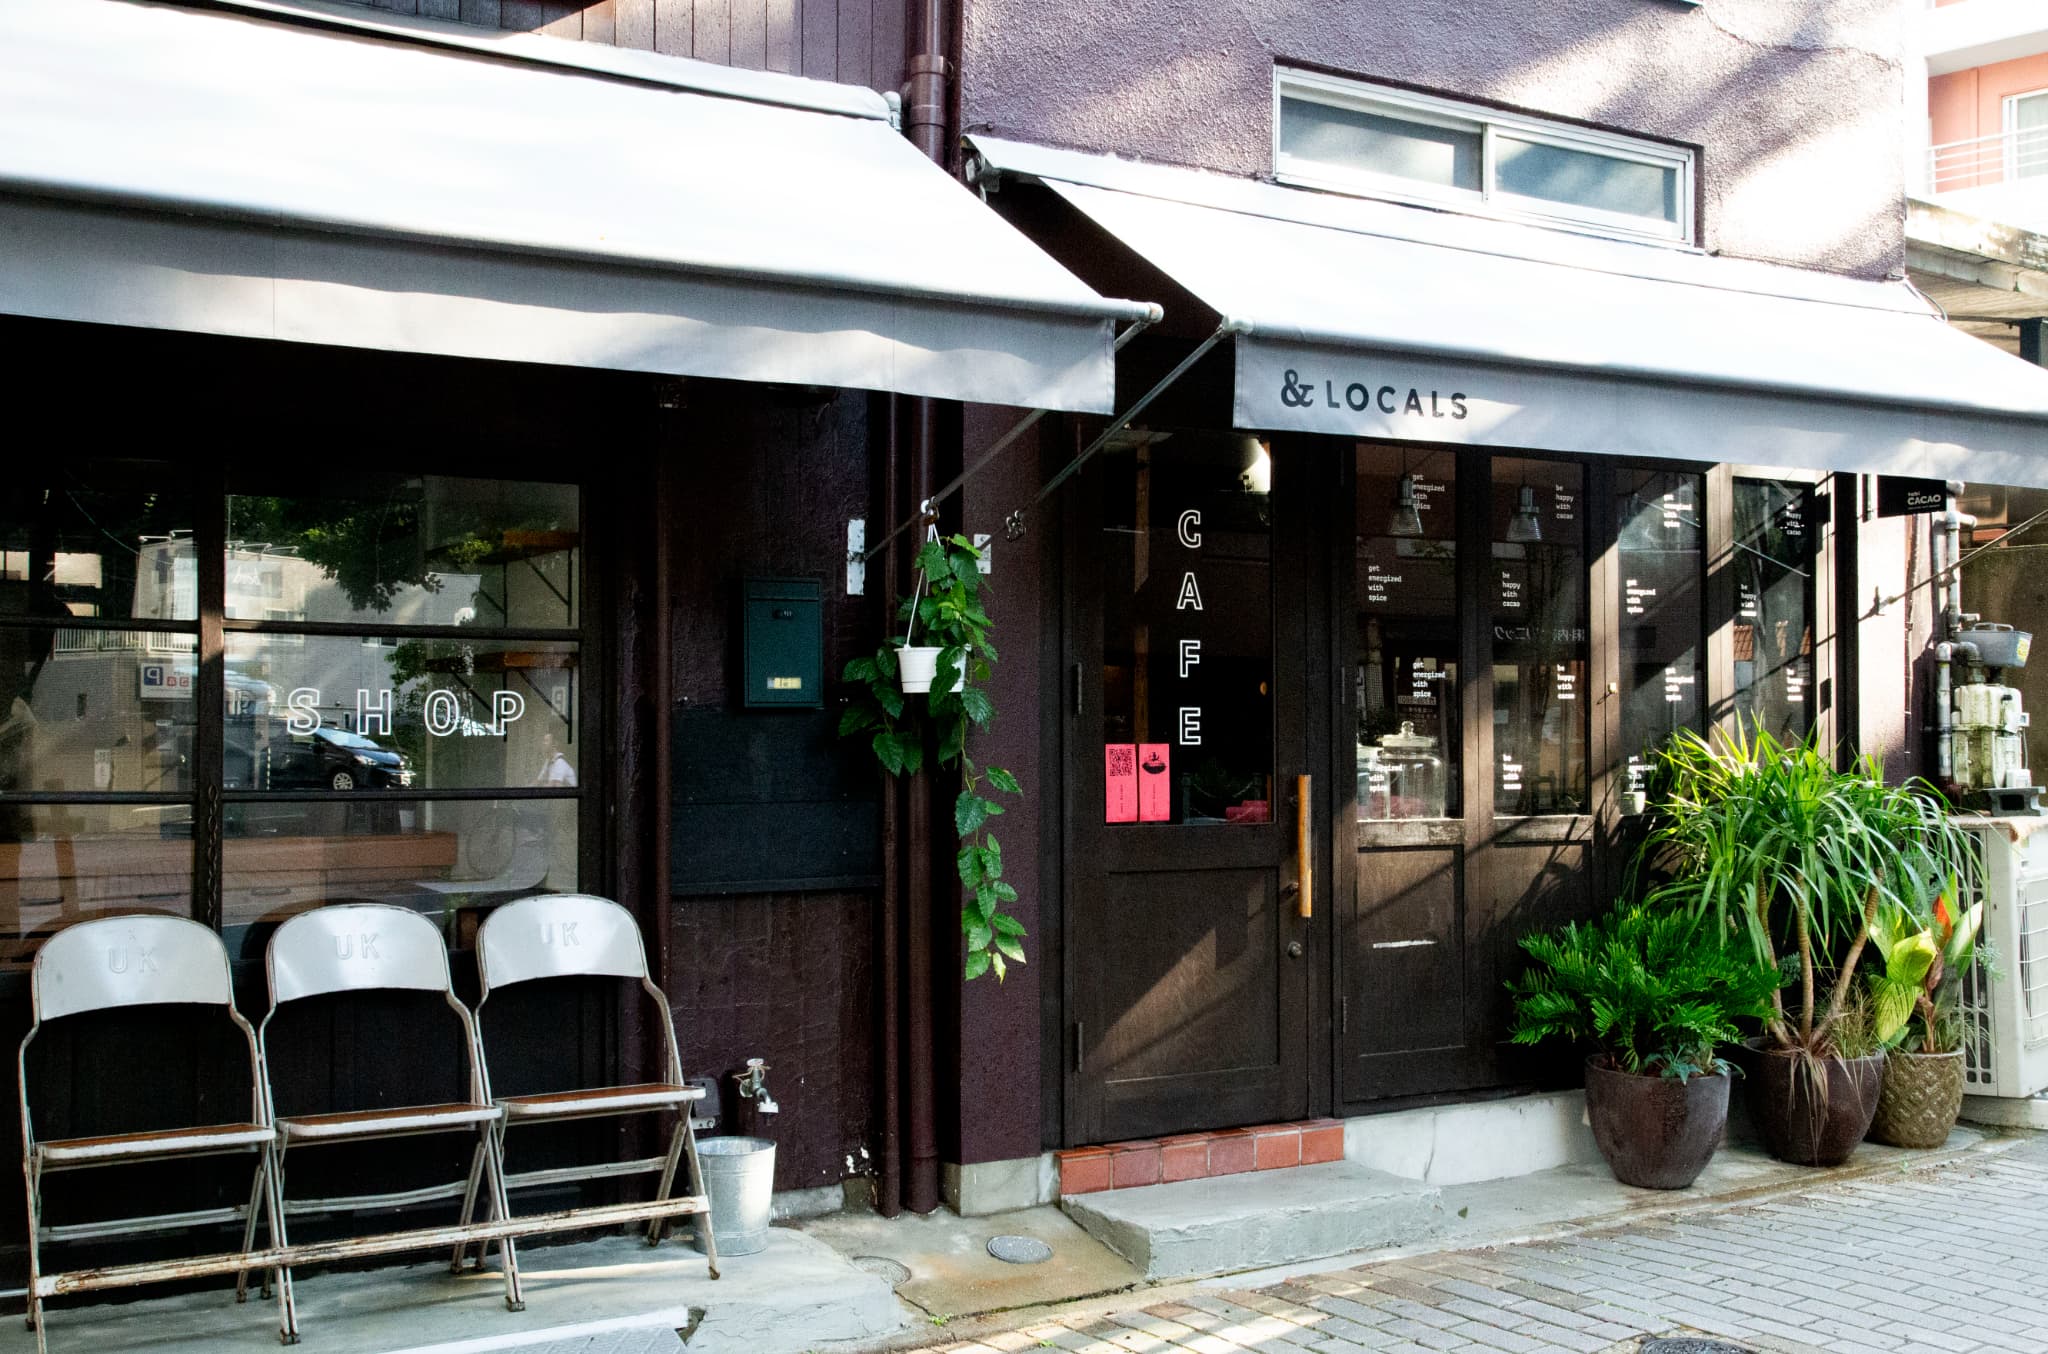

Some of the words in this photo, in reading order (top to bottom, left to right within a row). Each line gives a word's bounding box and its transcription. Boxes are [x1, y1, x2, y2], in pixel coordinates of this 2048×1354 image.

[1281, 369, 1314, 408] &
[1326, 380, 1467, 419] LOCALS
[1556, 494, 1573, 502] happy
[1907, 494, 1941, 505] CACAO
[1368, 575, 1402, 583] energized
[1502, 581, 1521, 589] happy
[1368, 594, 1387, 602] spice
[1176, 509, 1203, 745] CAFE
[287, 687, 525, 736] SHOP
[336, 934, 380, 960] UK
[109, 945, 160, 976] UK
